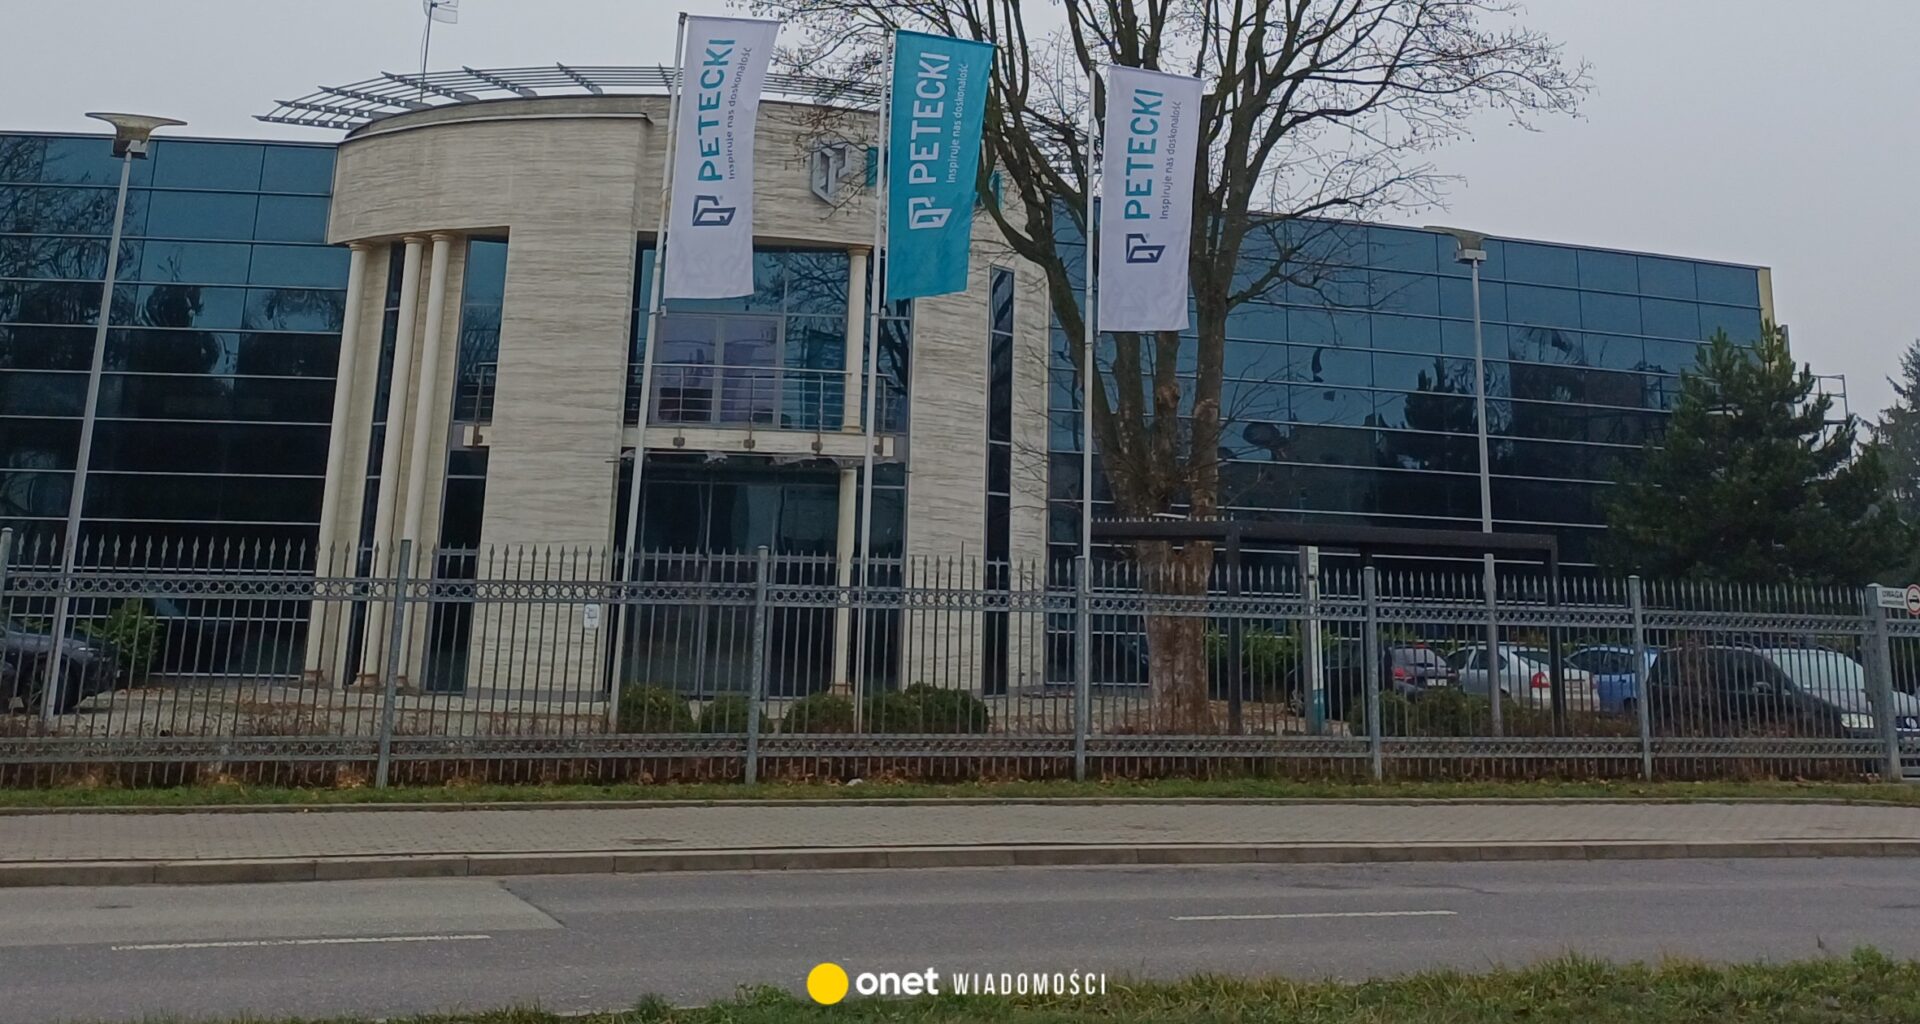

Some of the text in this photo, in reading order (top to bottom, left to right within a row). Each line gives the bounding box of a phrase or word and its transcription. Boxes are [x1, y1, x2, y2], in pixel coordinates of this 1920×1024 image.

[698, 39, 736, 181] PETECKI
[725, 47, 752, 180] Inspiruje nas doskonałość
[908, 52, 950, 185] PETECKI
[946, 63, 968, 183] Inspiruje nas doskonałość
[1124, 88, 1164, 220] PETECKI
[1160, 101, 1182, 220] Inspiruje nas doskonałość
